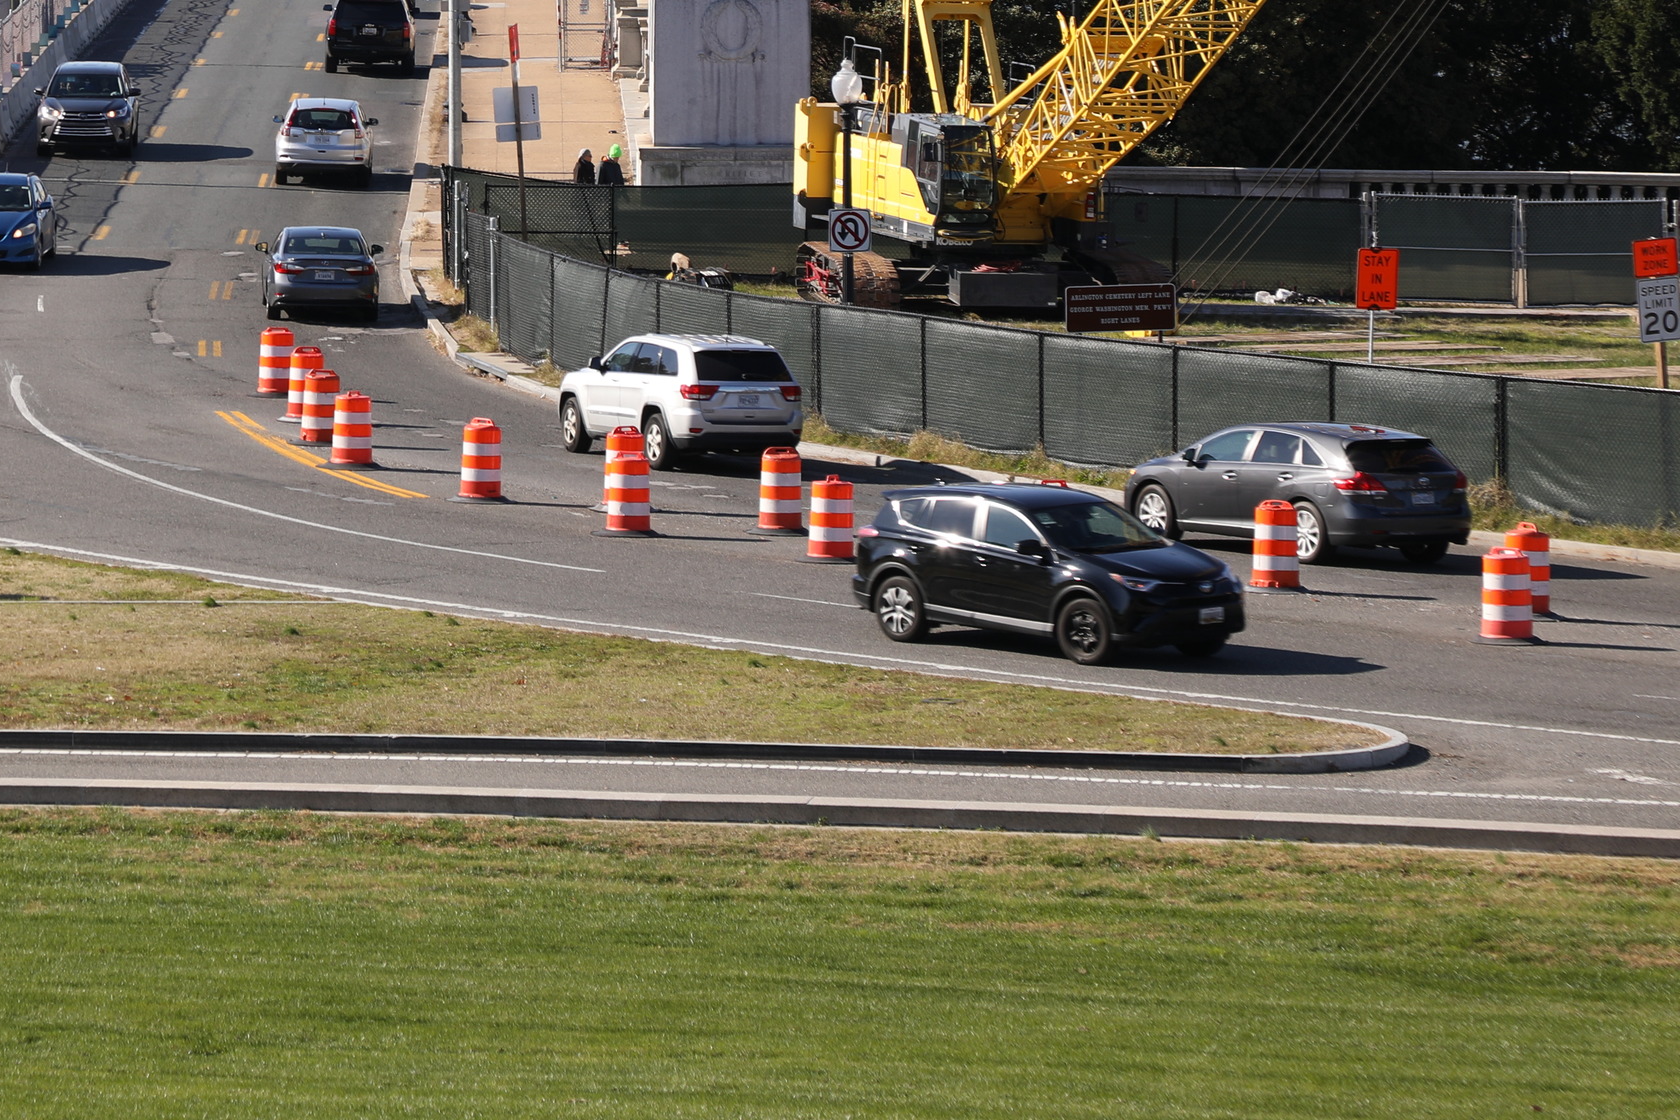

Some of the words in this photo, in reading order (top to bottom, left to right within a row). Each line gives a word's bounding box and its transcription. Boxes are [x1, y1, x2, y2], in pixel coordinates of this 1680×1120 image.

[1641, 245, 1669, 256] WORK
[1364, 255, 1392, 267] STAY
[1643, 259, 1669, 271] ZONE
[1371, 273, 1383, 285] IN
[1361, 291, 1391, 302] LANE
[1641, 284, 1677, 297] SPEED
[1645, 298, 1674, 310] LIMIT
[1644, 310, 1679, 335] 20
